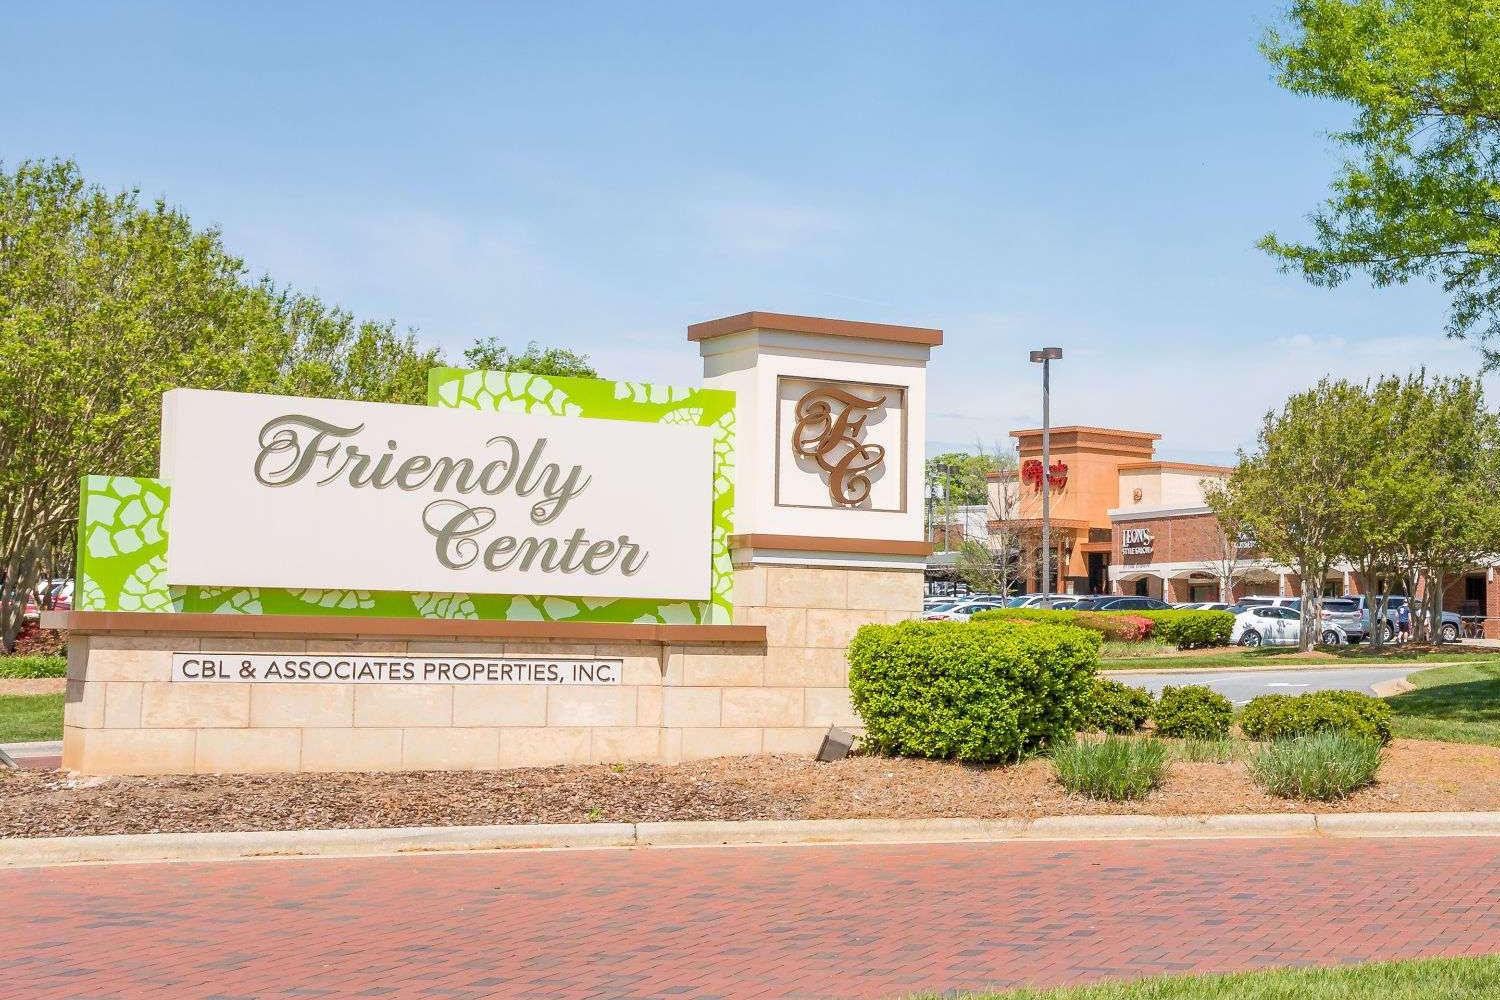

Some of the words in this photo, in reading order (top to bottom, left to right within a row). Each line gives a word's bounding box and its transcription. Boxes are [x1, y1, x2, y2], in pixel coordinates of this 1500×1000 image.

[254, 414, 592, 526] Friendly
[421, 499, 649, 577] Center
[182, 659, 231, 679] CBL
[238, 660, 257, 679] &
[263, 660, 416, 681] ASSOCIATES
[423, 662, 565, 683] PROPERTIES,
[572, 664, 617, 683] INC.
